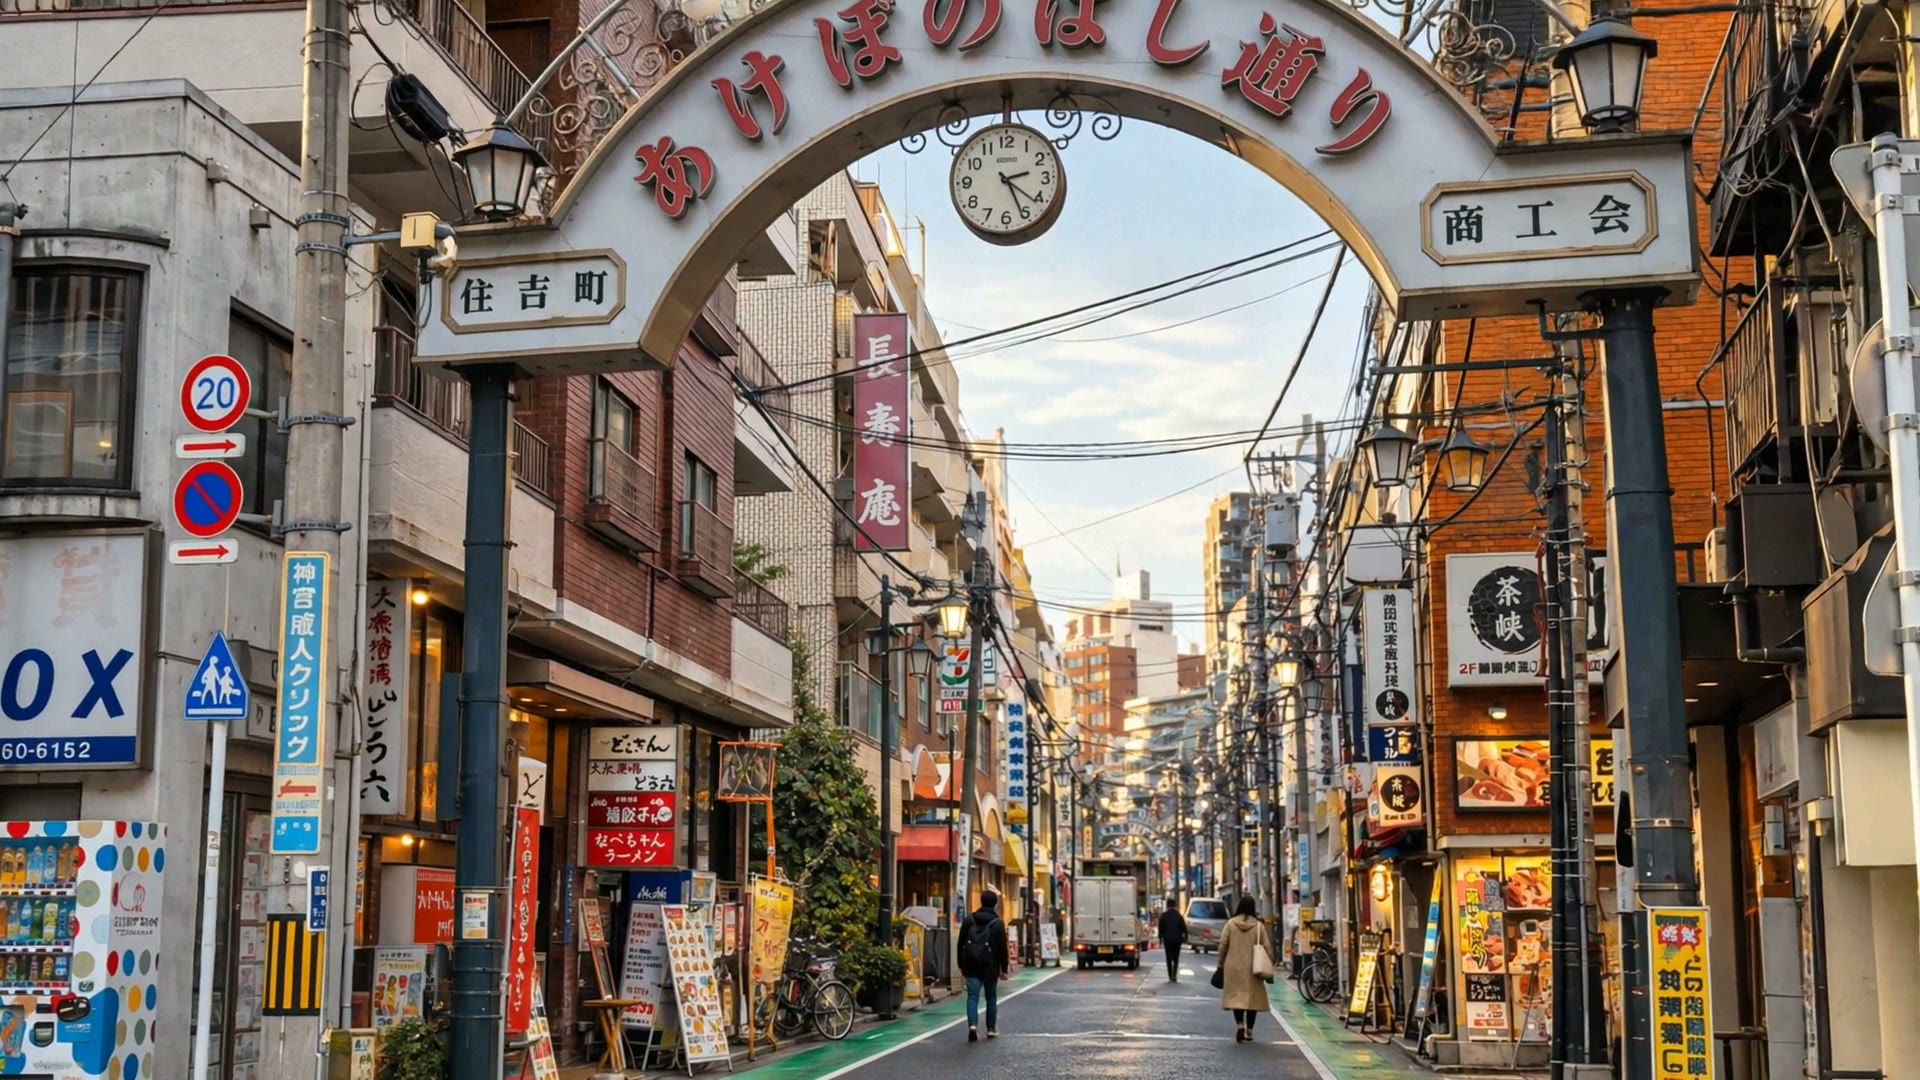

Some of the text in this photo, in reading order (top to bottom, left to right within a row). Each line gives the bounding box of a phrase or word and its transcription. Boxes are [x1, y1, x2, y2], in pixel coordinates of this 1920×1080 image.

[982, 142, 993, 155] 11
[1000, 135, 1015, 148] 12
[1024, 139, 1029, 153] 1
[968, 157, 982, 170] 10
[1035, 152, 1045, 166] 2
[962, 176, 973, 189] 9
[1040, 171, 1050, 185] 3
[967, 195, 978, 209] 8
[982, 208, 993, 222] 7
[1001, 211, 1012, 225] 6
[1020, 206, 1031, 219] 5
[1442, 194, 1632, 246] 商工会
[460, 270, 609, 315] 住吉町
[196, 376, 235, 410] 20
[1494, 575, 1526, 642] 茶峡
[1459, 663, 1477, 676] 2F
[604, 848, 657, 865] ラーメン
